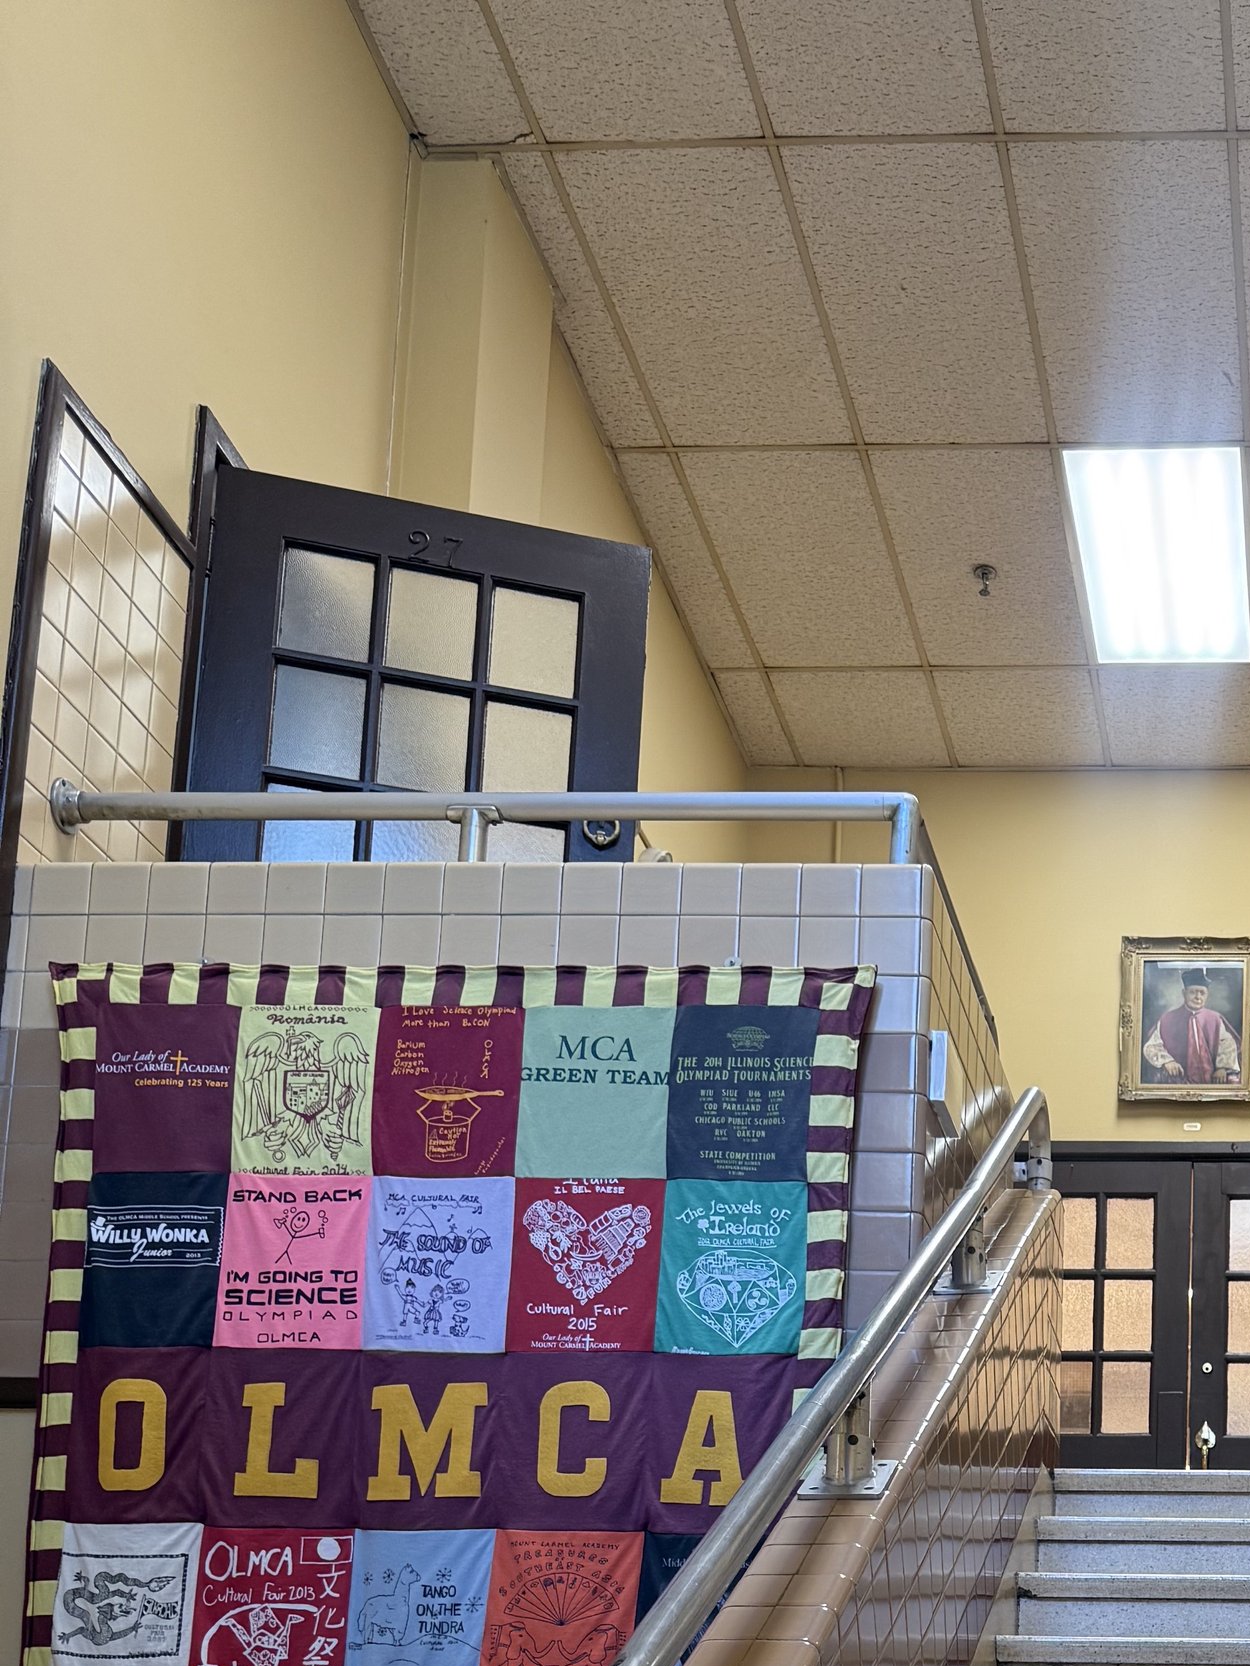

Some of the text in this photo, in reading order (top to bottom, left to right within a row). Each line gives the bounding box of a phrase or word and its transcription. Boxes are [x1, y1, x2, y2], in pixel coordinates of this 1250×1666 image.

[408, 529, 463, 568] 27
[402, 1007, 409, 1016] I
[413, 1007, 434, 1015] Love
[478, 1006, 517, 1017] Olympiad
[402, 1020, 424, 1028] More
[428, 1020, 450, 1028] than
[397, 1039, 426, 1049] Barium
[555, 1035, 637, 1062] MCA
[112, 1050, 171, 1064] Our Lady of
[395, 1050, 424, 1058] Carbon
[95, 1062, 230, 1074] MOUNT CARMEL ACADEMY
[393, 1059, 424, 1067] Oxygen
[678, 1057, 698, 1070] THE
[704, 1057, 722, 1067] 2014
[727, 1057, 771, 1071] ILLINOIS
[391, 1066, 430, 1076] Nitrogen
[520, 1067, 670, 1085] GREEN TEAM
[676, 1069, 812, 1083] OLYMPIAD TOURNAMENTS
[135, 1078, 184, 1088] Celebrating
[205, 1079, 229, 1088] Years
[722, 1102, 761, 1111] PARKLAND
[695, 1116, 786, 1126] CHICAGO PUBLIC SCHOOLS
[736, 1129, 766, 1138] OAKTON
[700, 1150, 776, 1160] STATE COMPETITION
[293, 1166, 320, 1176] Fair
[232, 1189, 362, 1203] STAND BACK
[411, 1194, 455, 1202] CULTURAL
[675, 1207, 706, 1224] The
[710, 1199, 762, 1215] Jewels
[90, 1223, 210, 1243] WILLY WONKA
[379, 1228, 411, 1249] THE
[417, 1234, 467, 1253] SOUND
[129, 1239, 173, 1262] Junior
[396, 1255, 454, 1279] MUSIC
[226, 1270, 358, 1284] I'M GOING TO
[224, 1287, 358, 1306] SCIENCE
[223, 1310, 358, 1322] OLYMPIAD
[526, 1303, 628, 1316] Cultural Fair
[567, 1317, 597, 1331] 2015
[257, 1332, 321, 1343] OLMCA
[205, 1541, 293, 1581] OLMCA
[203, 1582, 315, 1606] Cultural Fair 2013
[421, 1584, 457, 1598] TANGO
[416, 1603, 462, 1617] ON THE
[418, 1621, 465, 1634] TUNDRA
